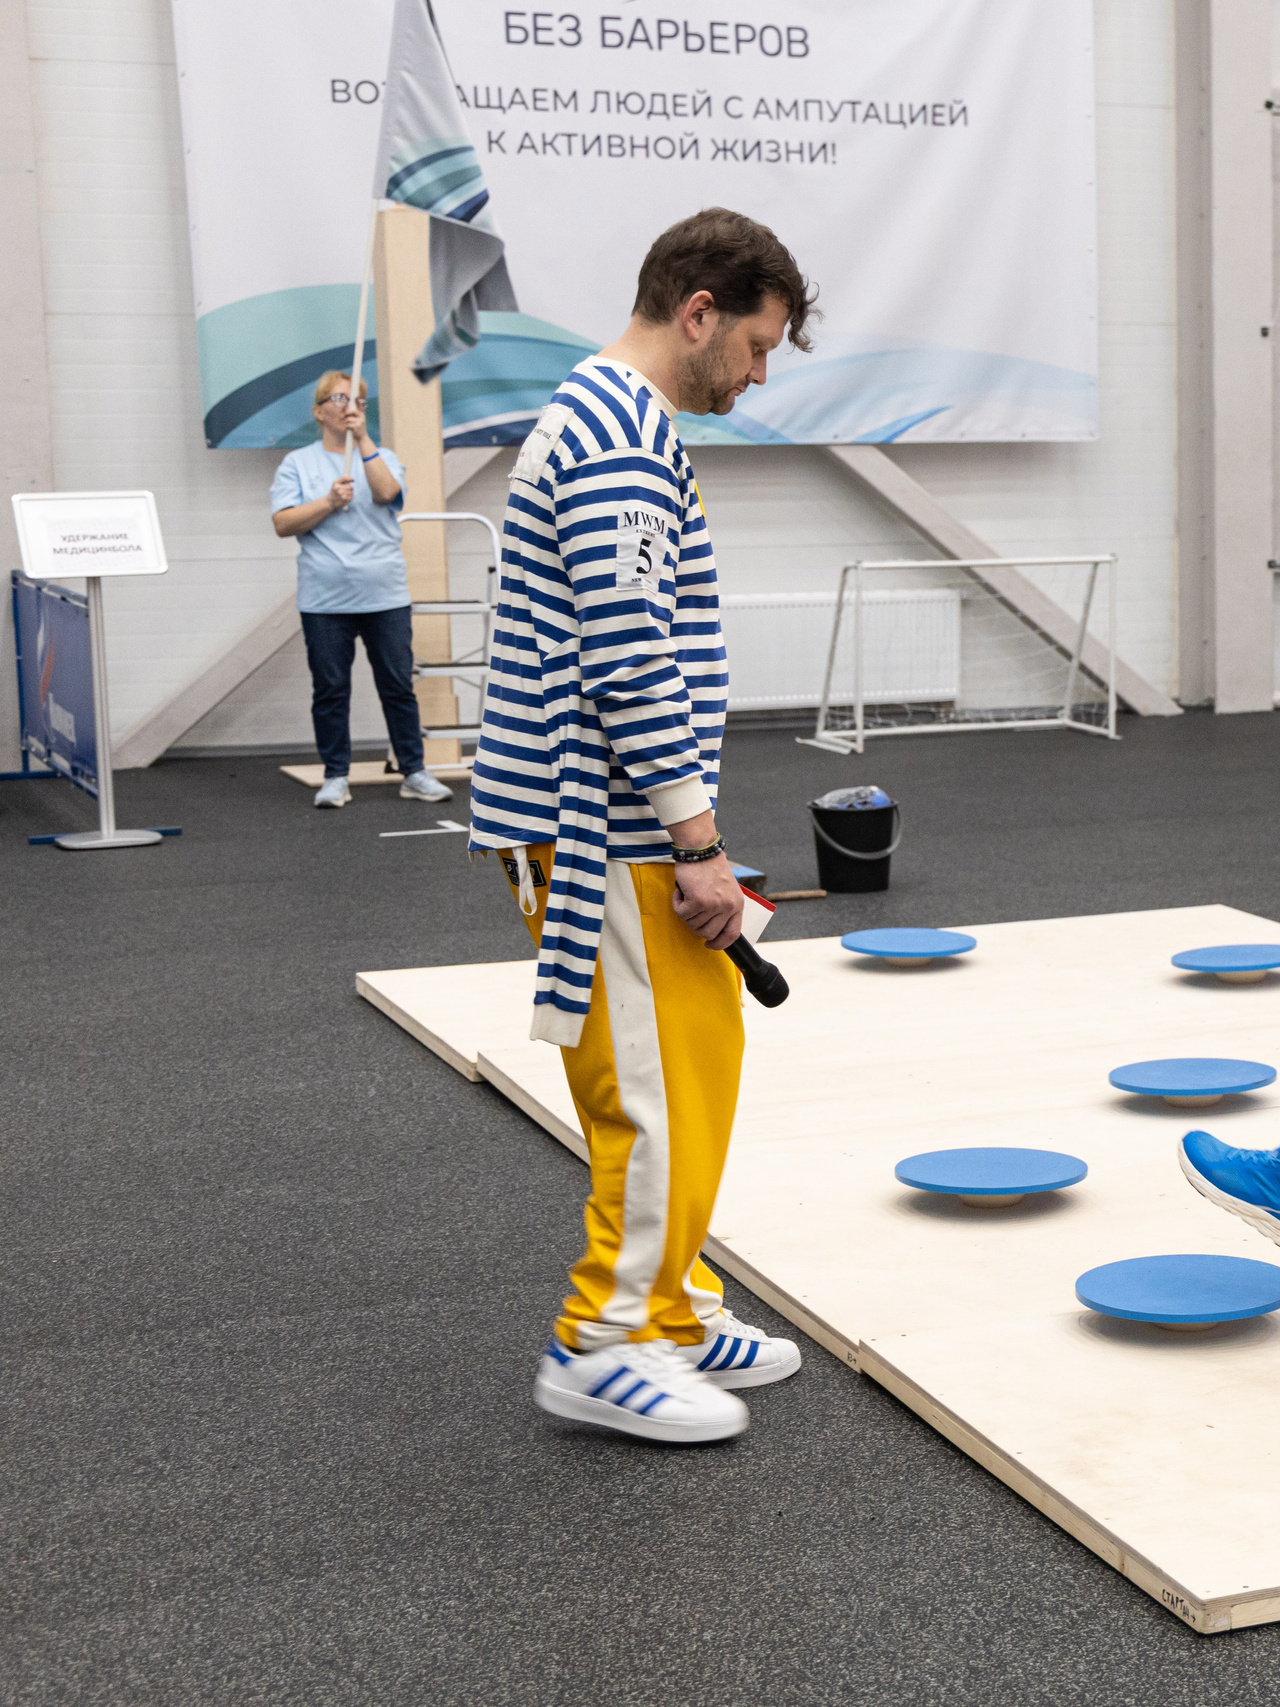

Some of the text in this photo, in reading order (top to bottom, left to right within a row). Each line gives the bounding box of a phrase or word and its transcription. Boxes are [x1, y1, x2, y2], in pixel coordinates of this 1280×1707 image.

[503, 11, 811, 59] БЕЗ БАРЬЕРОВ
[589, 88, 713, 121] ЛЮДЕЙ
[723, 95, 744, 119] С
[752, 96, 970, 129] АМПУТАЦИЕЙ
[487, 130, 837, 164] К АКТИВНОЙ ЖИЗНИ!
[60, 533, 129, 543] УДЕРЖАНИЕ
[623, 510, 666, 535] MWM
[52, 544, 143, 555] МЕДИЦИНБОЛА
[635, 537, 652, 575] 5
